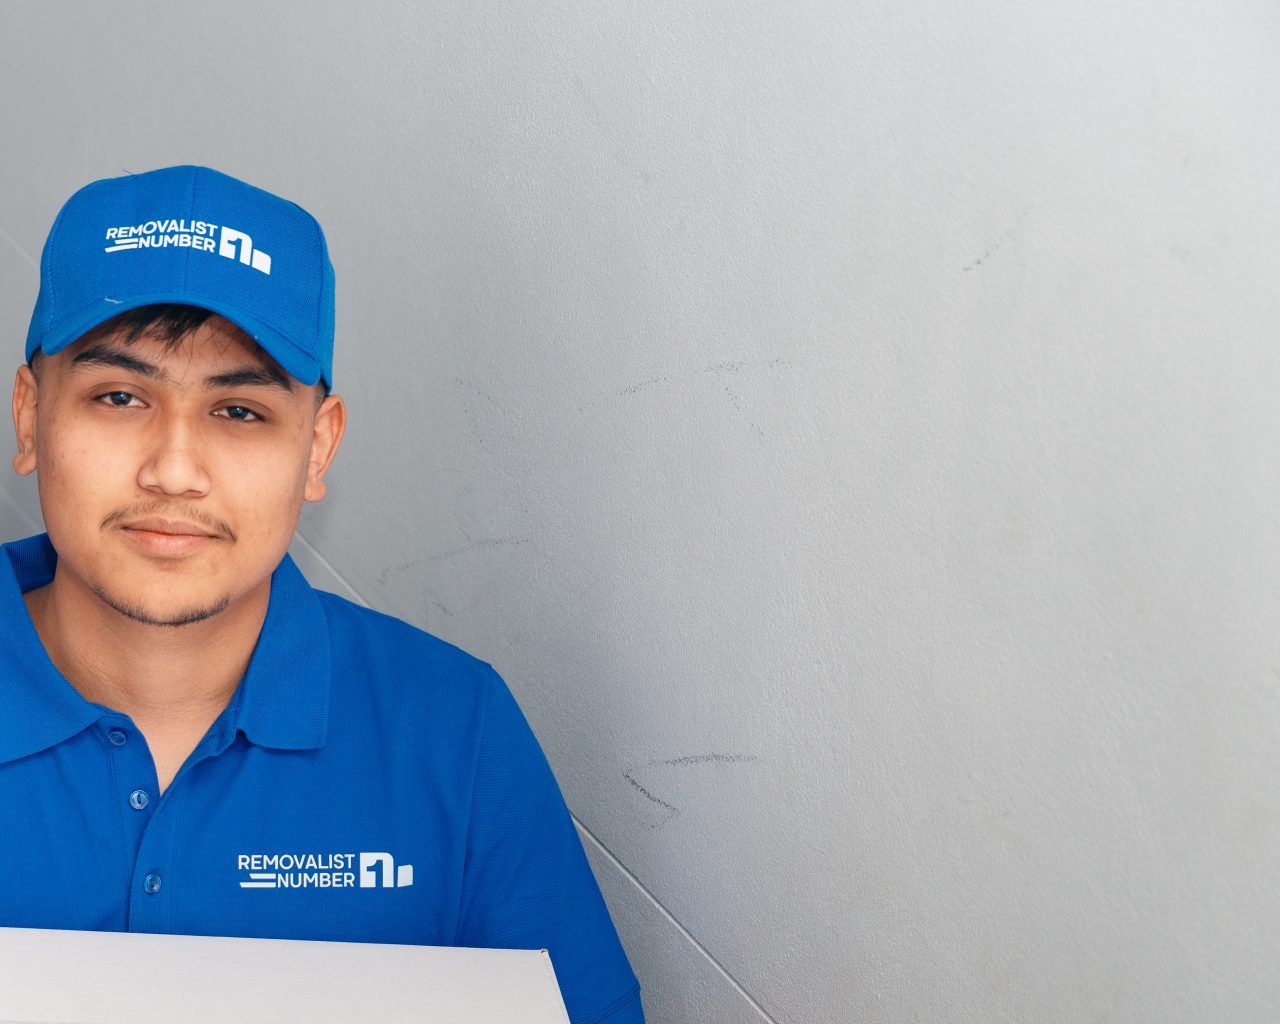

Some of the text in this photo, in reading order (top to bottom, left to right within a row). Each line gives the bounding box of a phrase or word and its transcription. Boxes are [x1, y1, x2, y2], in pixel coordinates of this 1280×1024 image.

[105, 219, 218, 240] REMOVALIST
[138, 234, 215, 253] NUMBER
[238, 854, 355, 870] REMOVALIST
[277, 873, 355, 888] NUMBER
